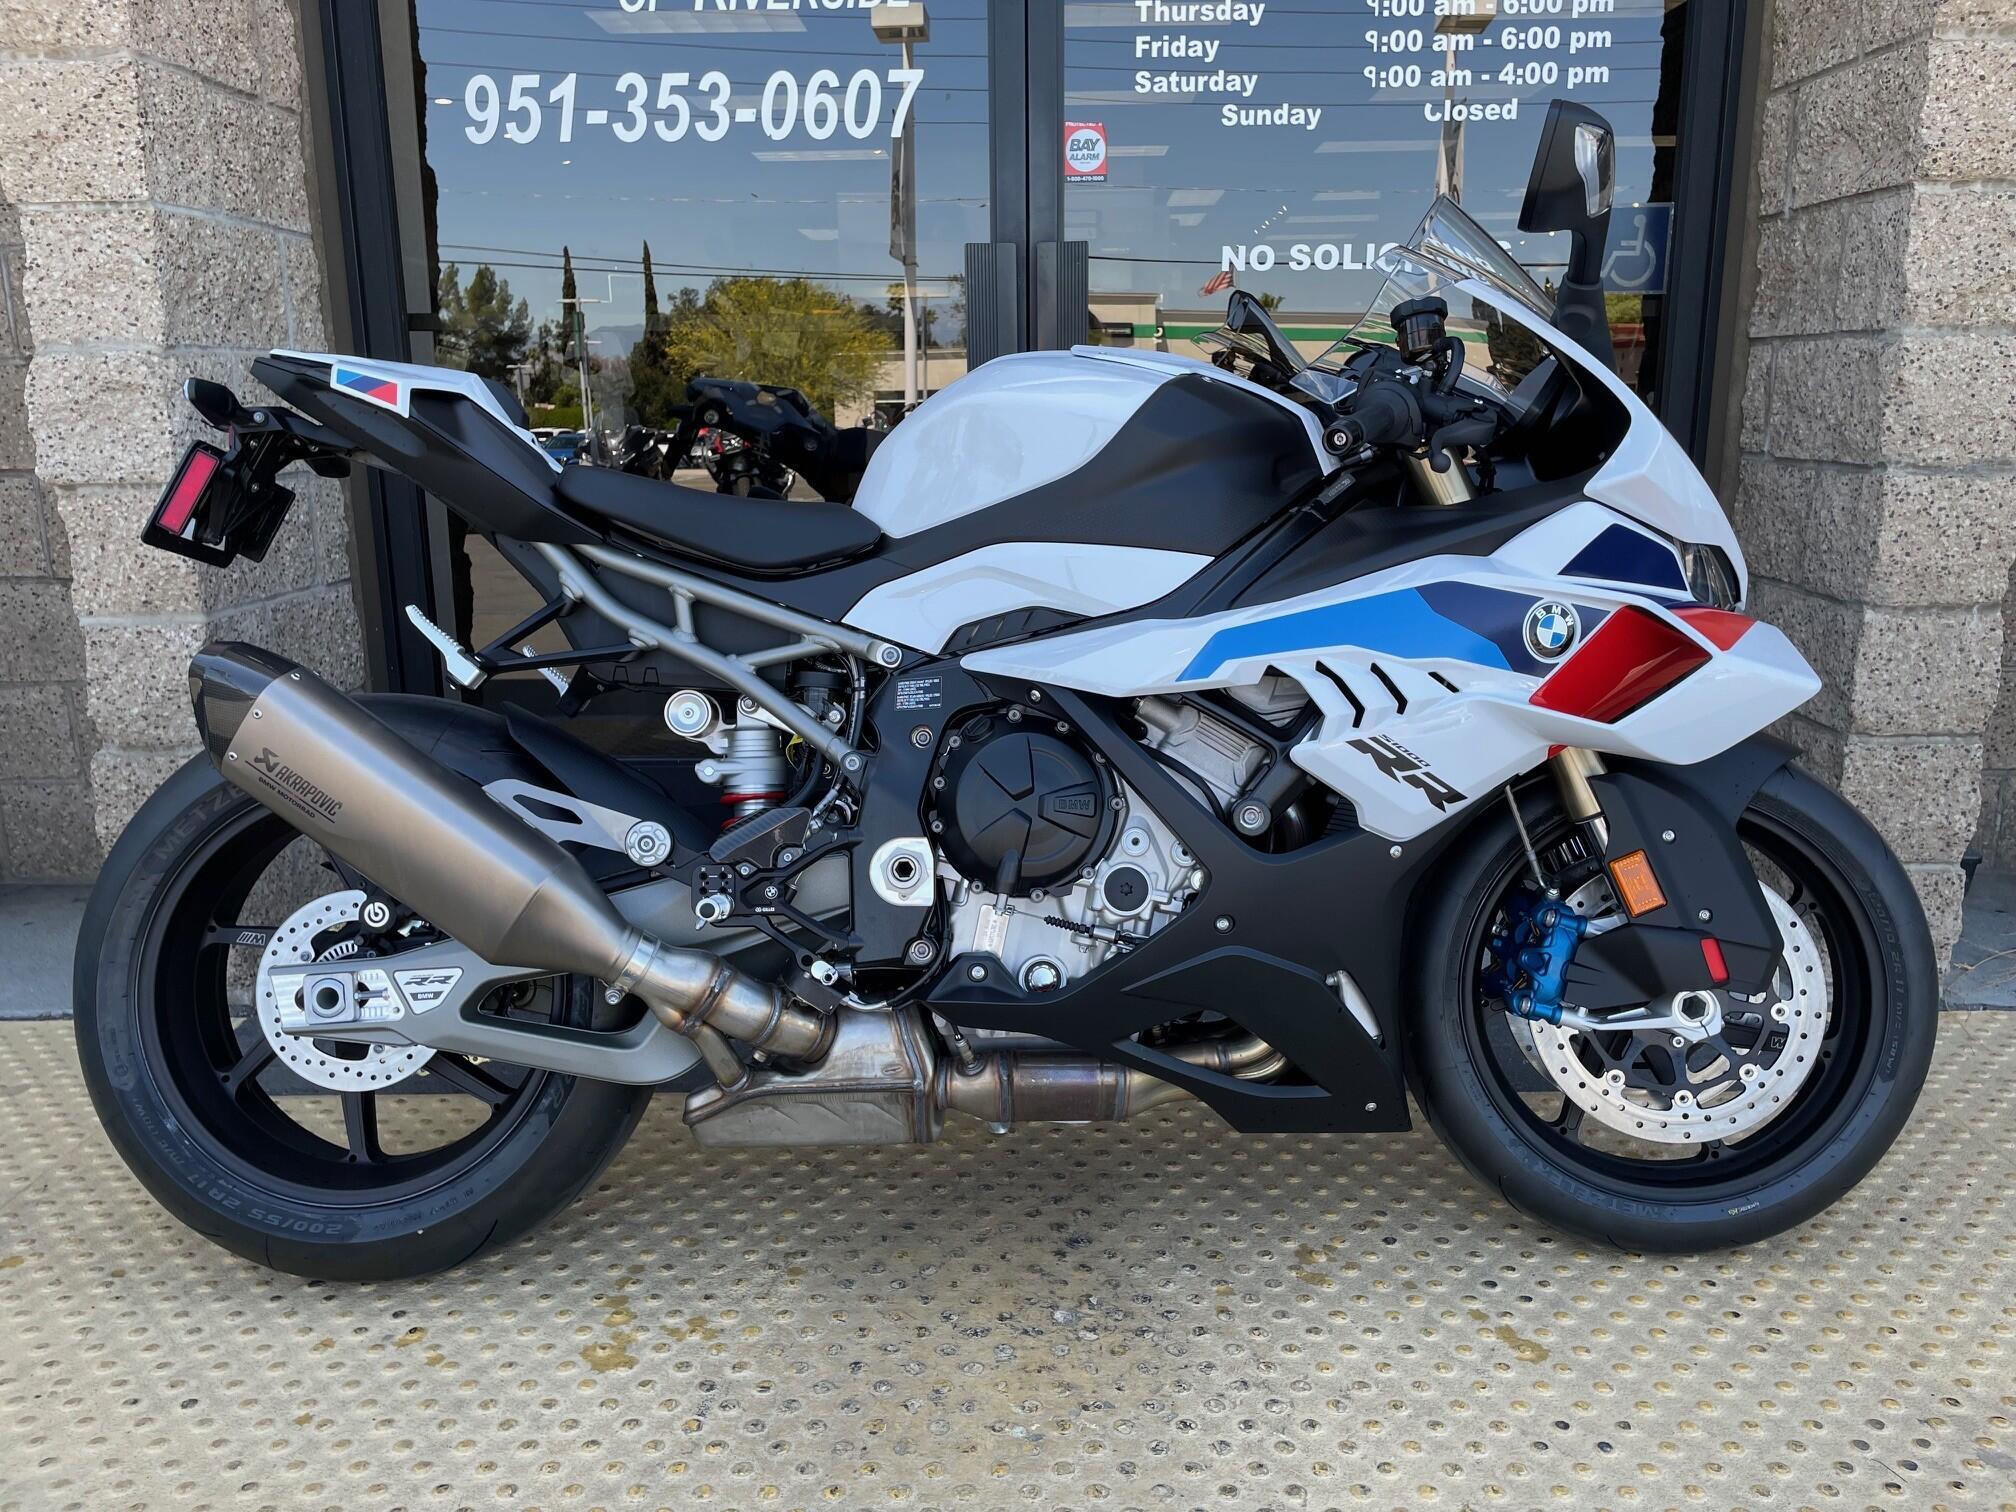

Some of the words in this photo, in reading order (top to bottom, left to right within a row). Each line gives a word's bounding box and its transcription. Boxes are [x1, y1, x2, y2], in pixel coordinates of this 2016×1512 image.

[1135, 0, 1265, 26] Thursday
[1434, 0, 1476, 16] am
[1571, 0, 1614, 18] pm
[1135, 35, 1220, 63] Friday
[1364, 29, 1423, 53] 9:00
[1432, 33, 1474, 51] am
[1501, 26, 1561, 50] 6:00
[1569, 30, 1612, 54] pm
[1135, 70, 1258, 97] Saturday
[1363, 65, 1421, 88] 9:00
[1430, 68, 1472, 87] am
[1498, 62, 1559, 85] 4:00
[1567, 66, 1609, 89] pm
[464, 69, 924, 144] 951-353-0607
[1221, 103, 1322, 130] Sunday
[1424, 98, 1518, 122] Closed
[1069, 138, 1101, 151] BAY
[1069, 153, 1100, 161] ALARM
[1221, 244, 1275, 272] NO
[1535, 605, 1574, 626] BMW
[1345, 736, 1468, 813] RR
[258, 776, 277, 791] BMW
[277, 789, 316, 819] MOTORRAD
[1058, 799, 1091, 810] BMW
[417, 992, 434, 1000] BMW
[247, 1207, 343, 1235] 200/55
